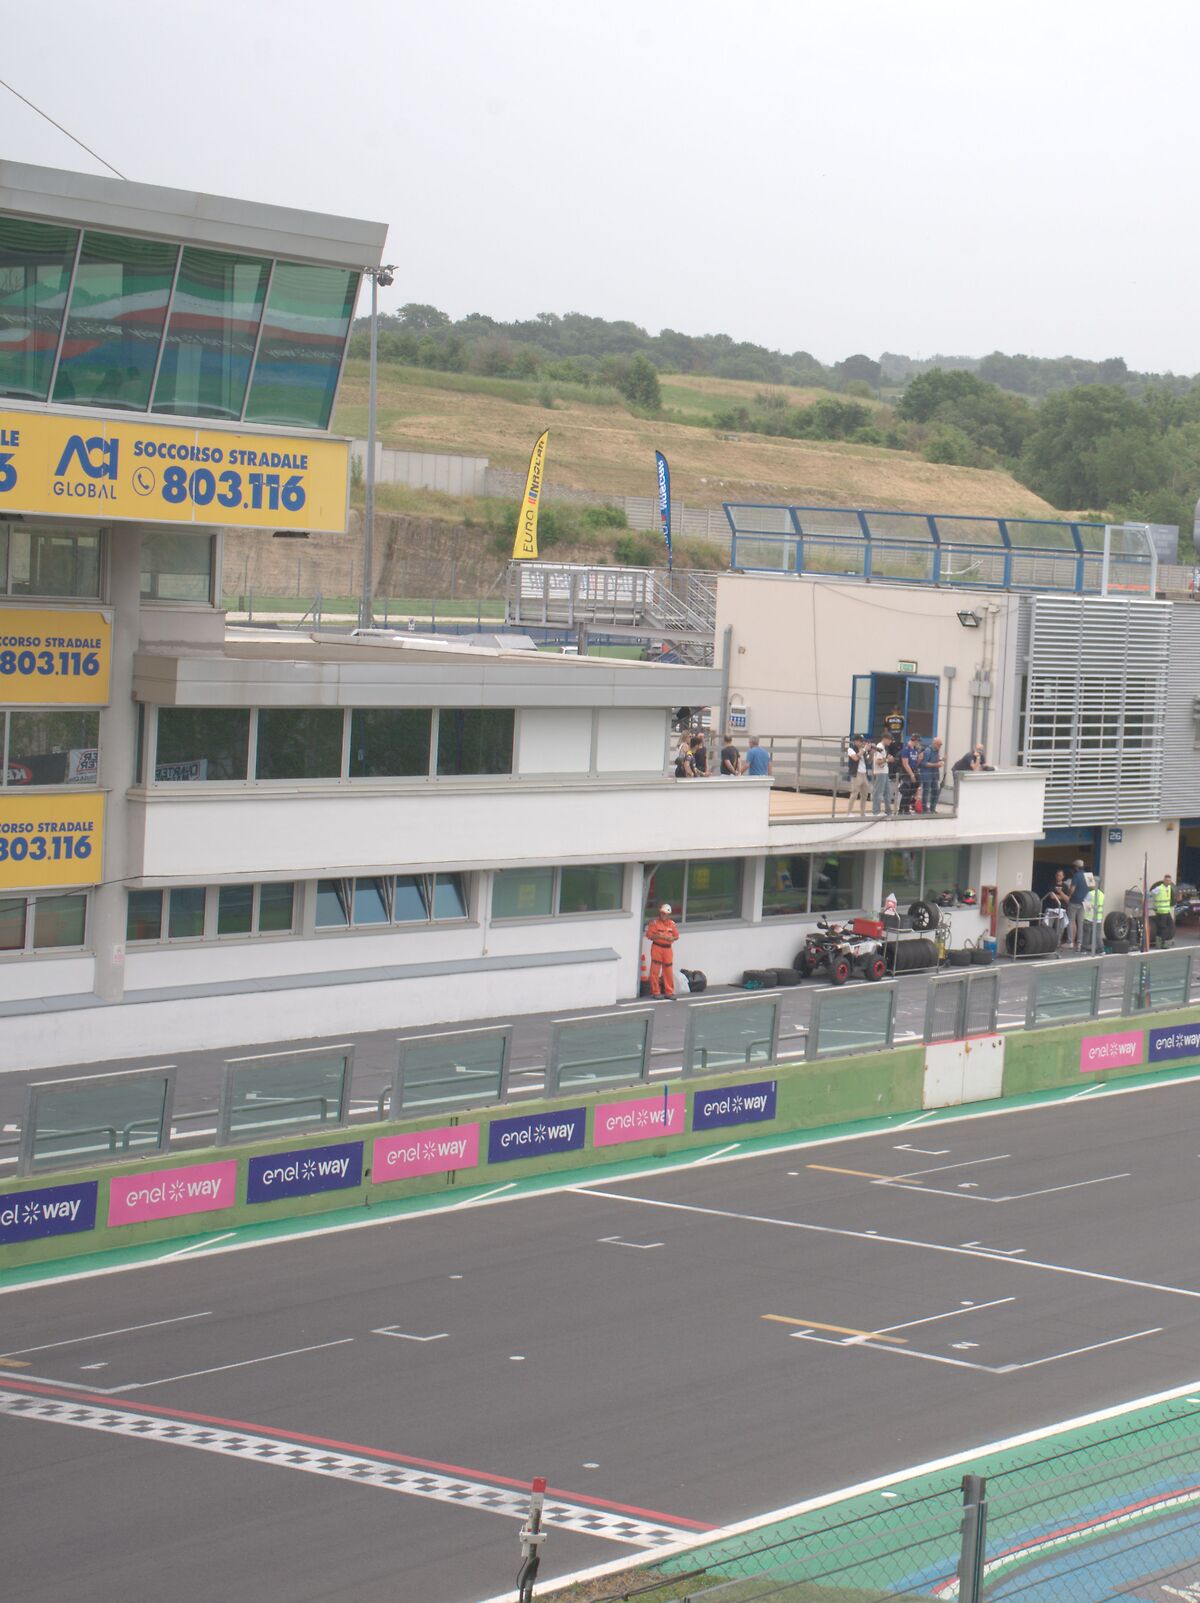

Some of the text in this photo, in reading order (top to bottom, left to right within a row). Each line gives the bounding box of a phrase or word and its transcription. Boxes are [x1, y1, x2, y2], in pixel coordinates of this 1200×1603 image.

[133, 441, 308, 470] SOCCORSO STRADALE
[53, 481, 117, 499] GLOBAL
[161, 466, 306, 512] 803.116
[45, 637, 102, 649] STRADALE
[0, 650, 100, 676] 803.116
[0, 821, 94, 833] ORSO STRADALE
[1109, 832, 1121, 841] 26
[1088, 1043, 1136, 1059] enel way
[1156, 1034, 1200, 1050] enel way
[704, 1096, 767, 1117] enel way
[606, 1112, 637, 1131] enel
[501, 1124, 574, 1148] enel way
[387, 1139, 468, 1165] enel way
[263, 1158, 349, 1185] enel way
[126, 1178, 221, 1207] enel way
[43, 1199, 81, 1221] way
